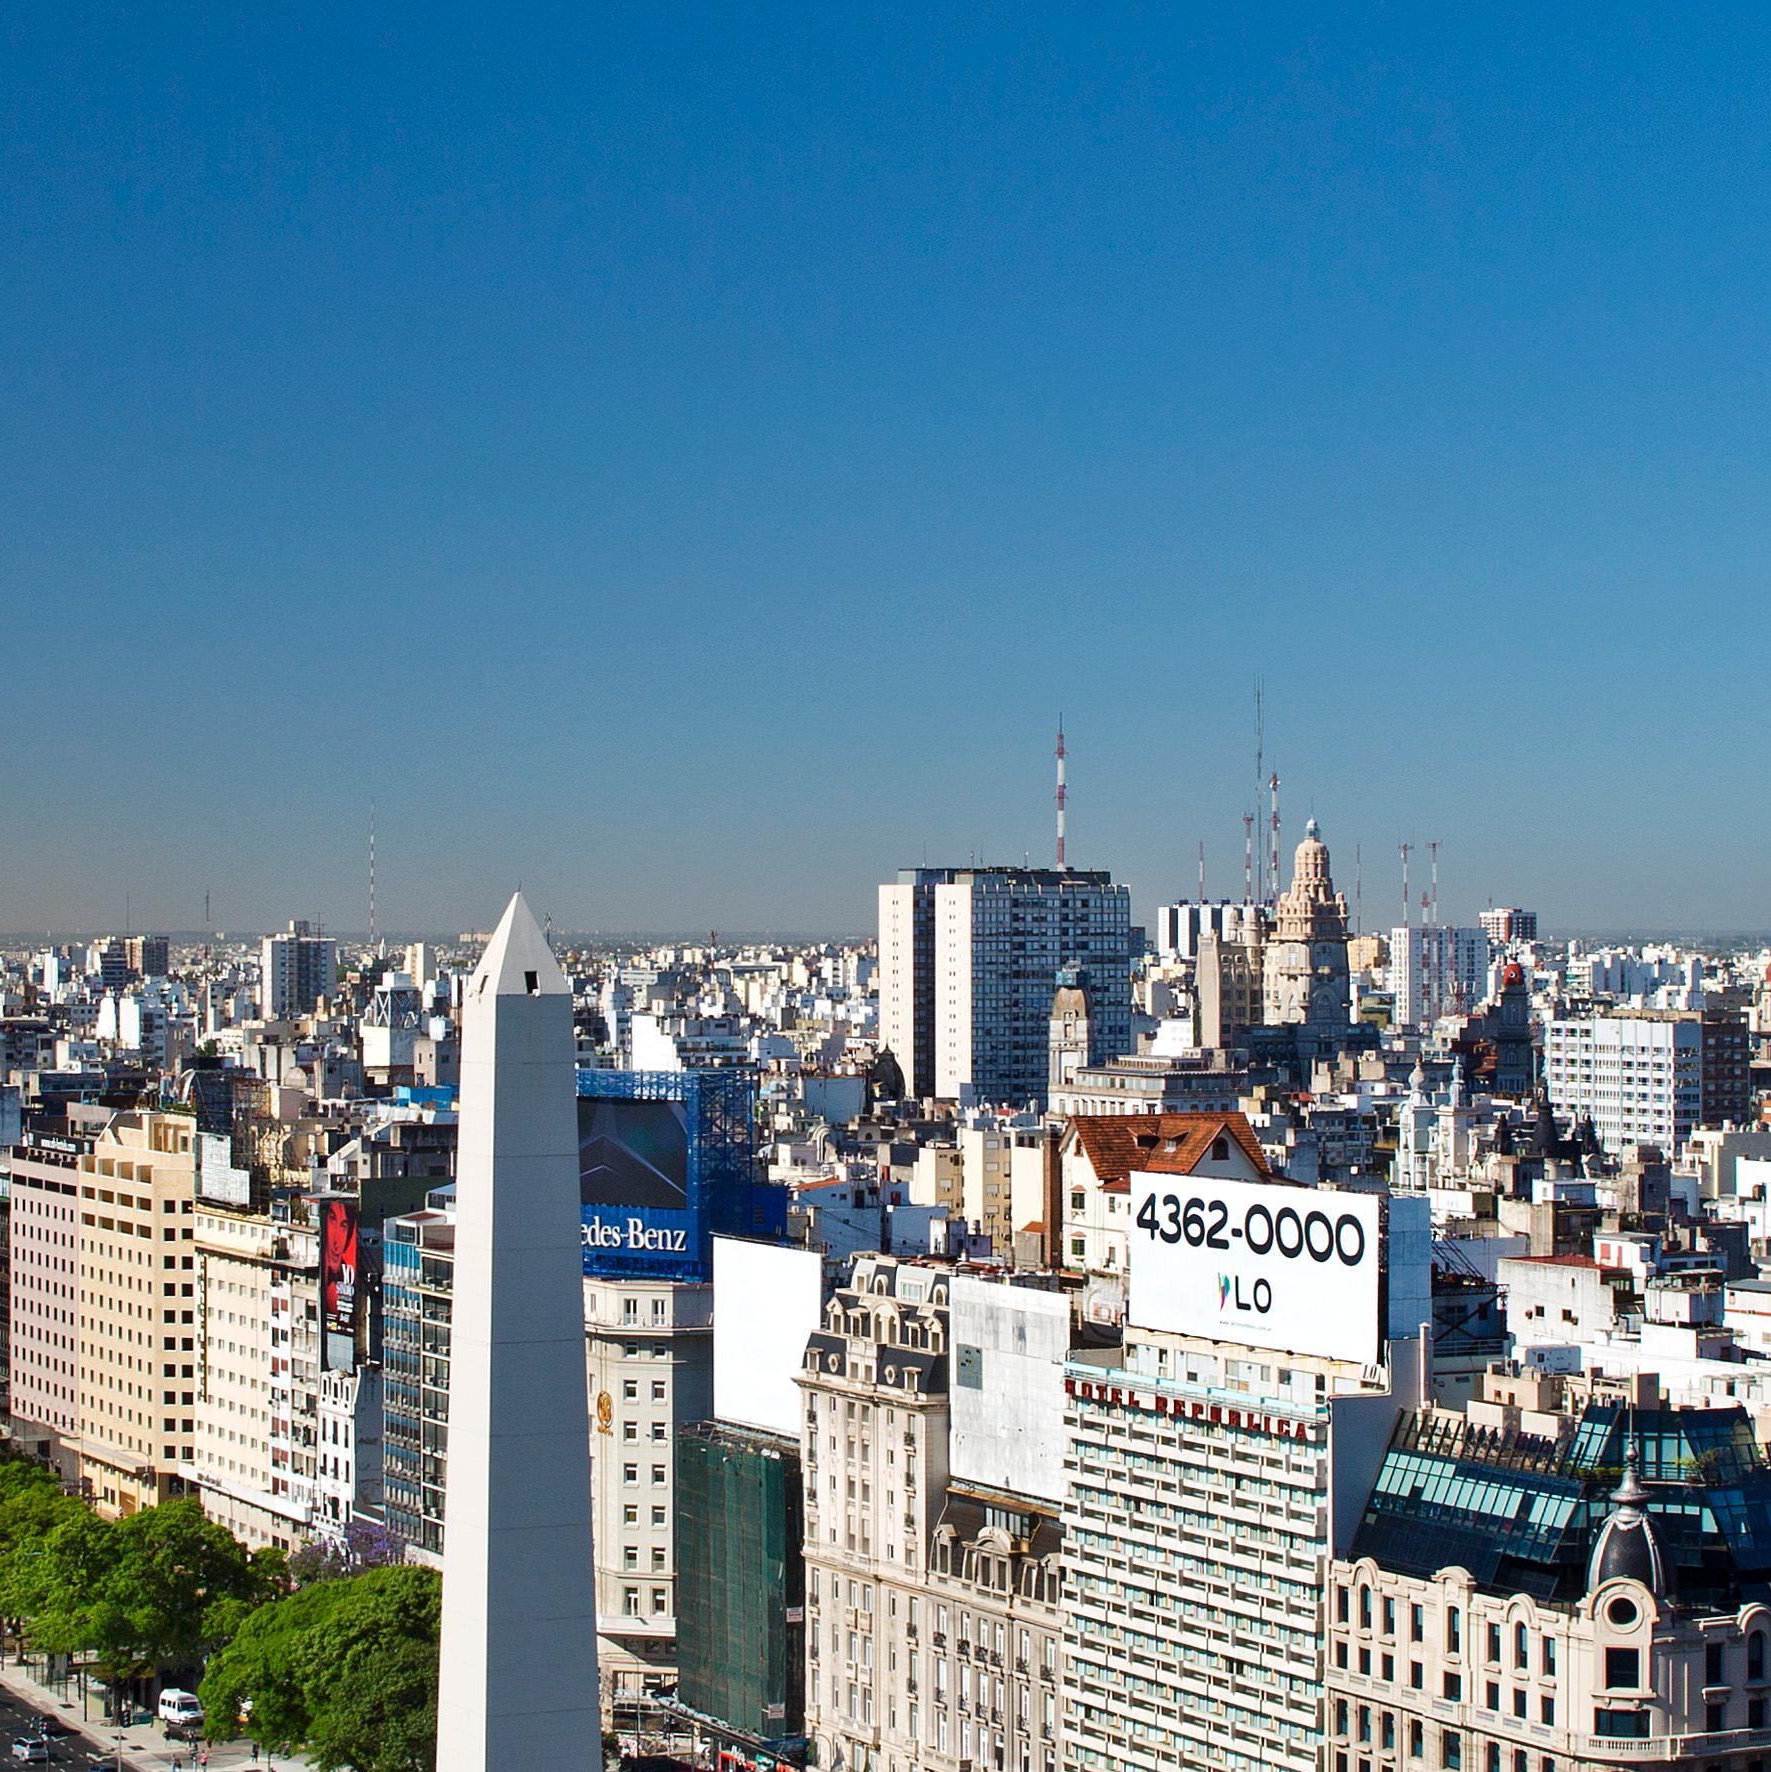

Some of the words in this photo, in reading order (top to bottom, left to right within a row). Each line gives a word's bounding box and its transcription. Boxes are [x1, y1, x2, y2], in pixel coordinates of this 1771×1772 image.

[1137, 1193, 1365, 1267] 4362-0000
[1235, 1275, 1272, 1314] LO
[1064, 1379, 1141, 1409] HOTEL
